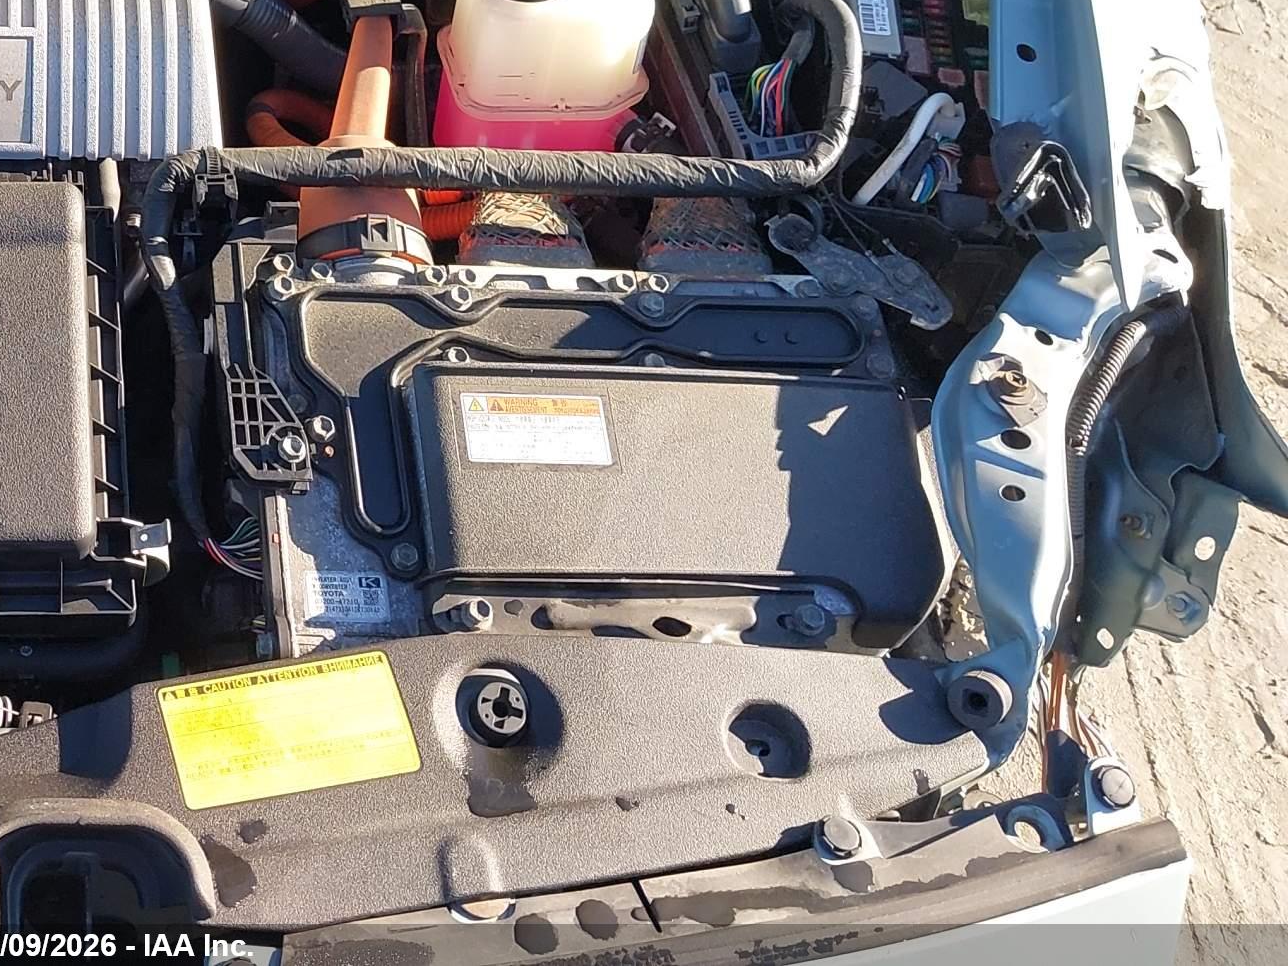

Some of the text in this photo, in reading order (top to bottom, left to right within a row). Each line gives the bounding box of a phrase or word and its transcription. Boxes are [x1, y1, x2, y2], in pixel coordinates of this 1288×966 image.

[321, 654, 381, 673] ВНИМАНИЕ
[203, 677, 252, 694] CAUTION
[256, 666, 318, 685] ATTENTION
